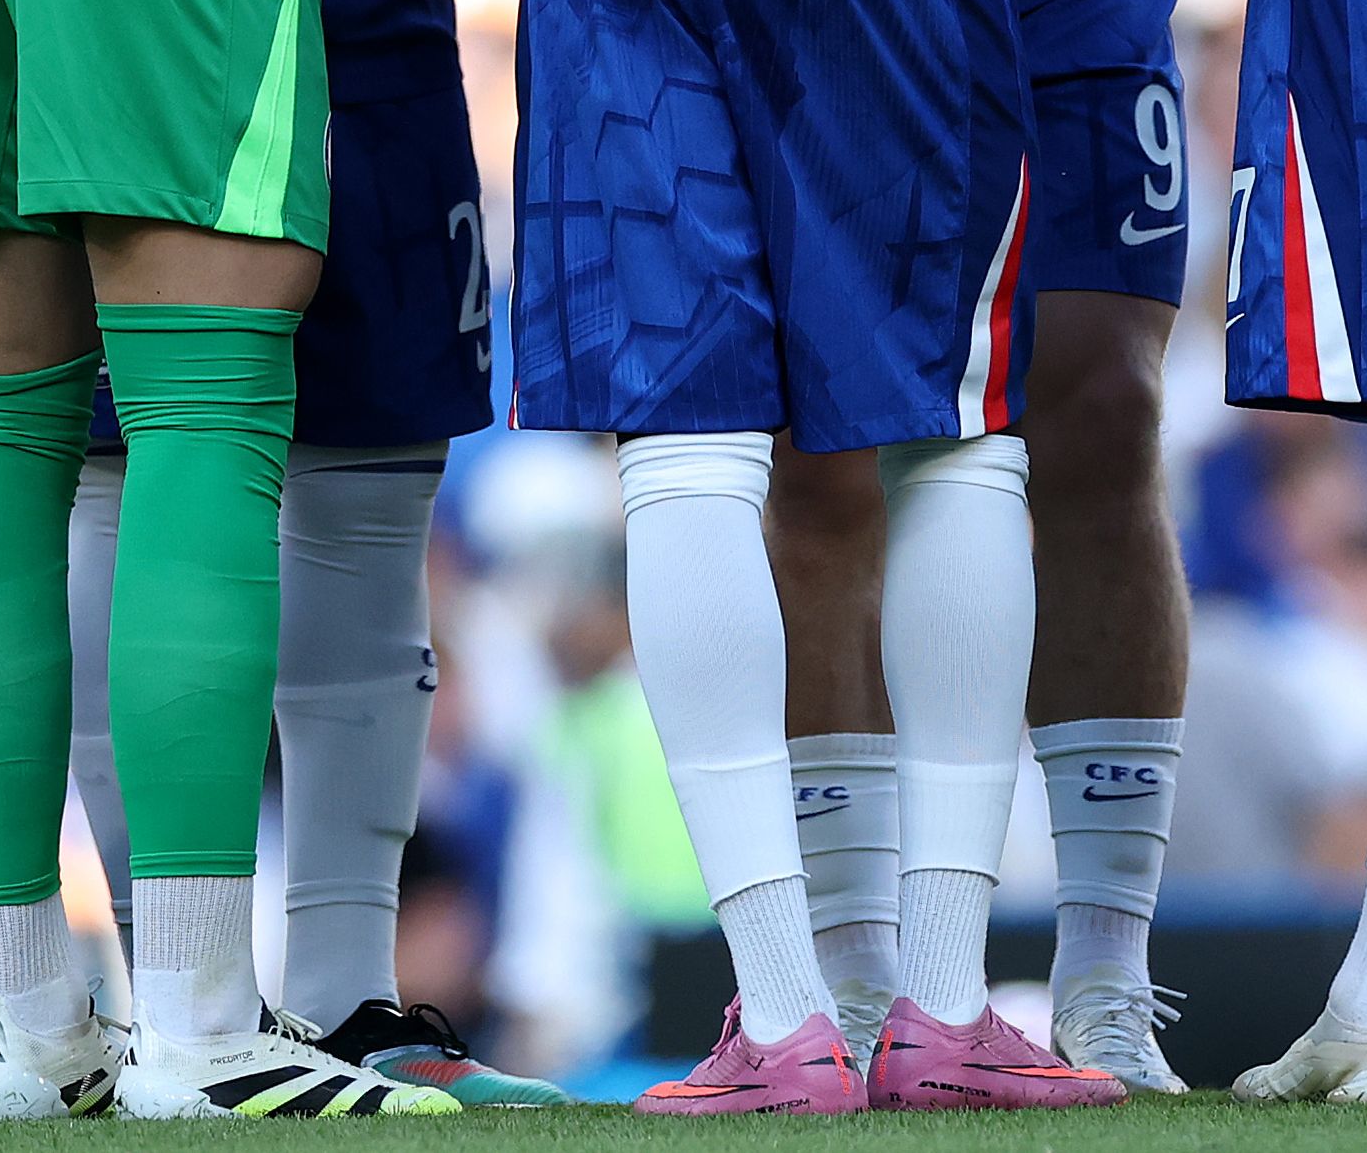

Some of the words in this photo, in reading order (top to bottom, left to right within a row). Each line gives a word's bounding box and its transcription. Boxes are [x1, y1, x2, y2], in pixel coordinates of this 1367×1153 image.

[1135, 83, 1182, 212] 9
[1085, 763, 1159, 785] CFC
[793, 785, 851, 802] FC
[209, 1050, 254, 1065] PREDATOR
